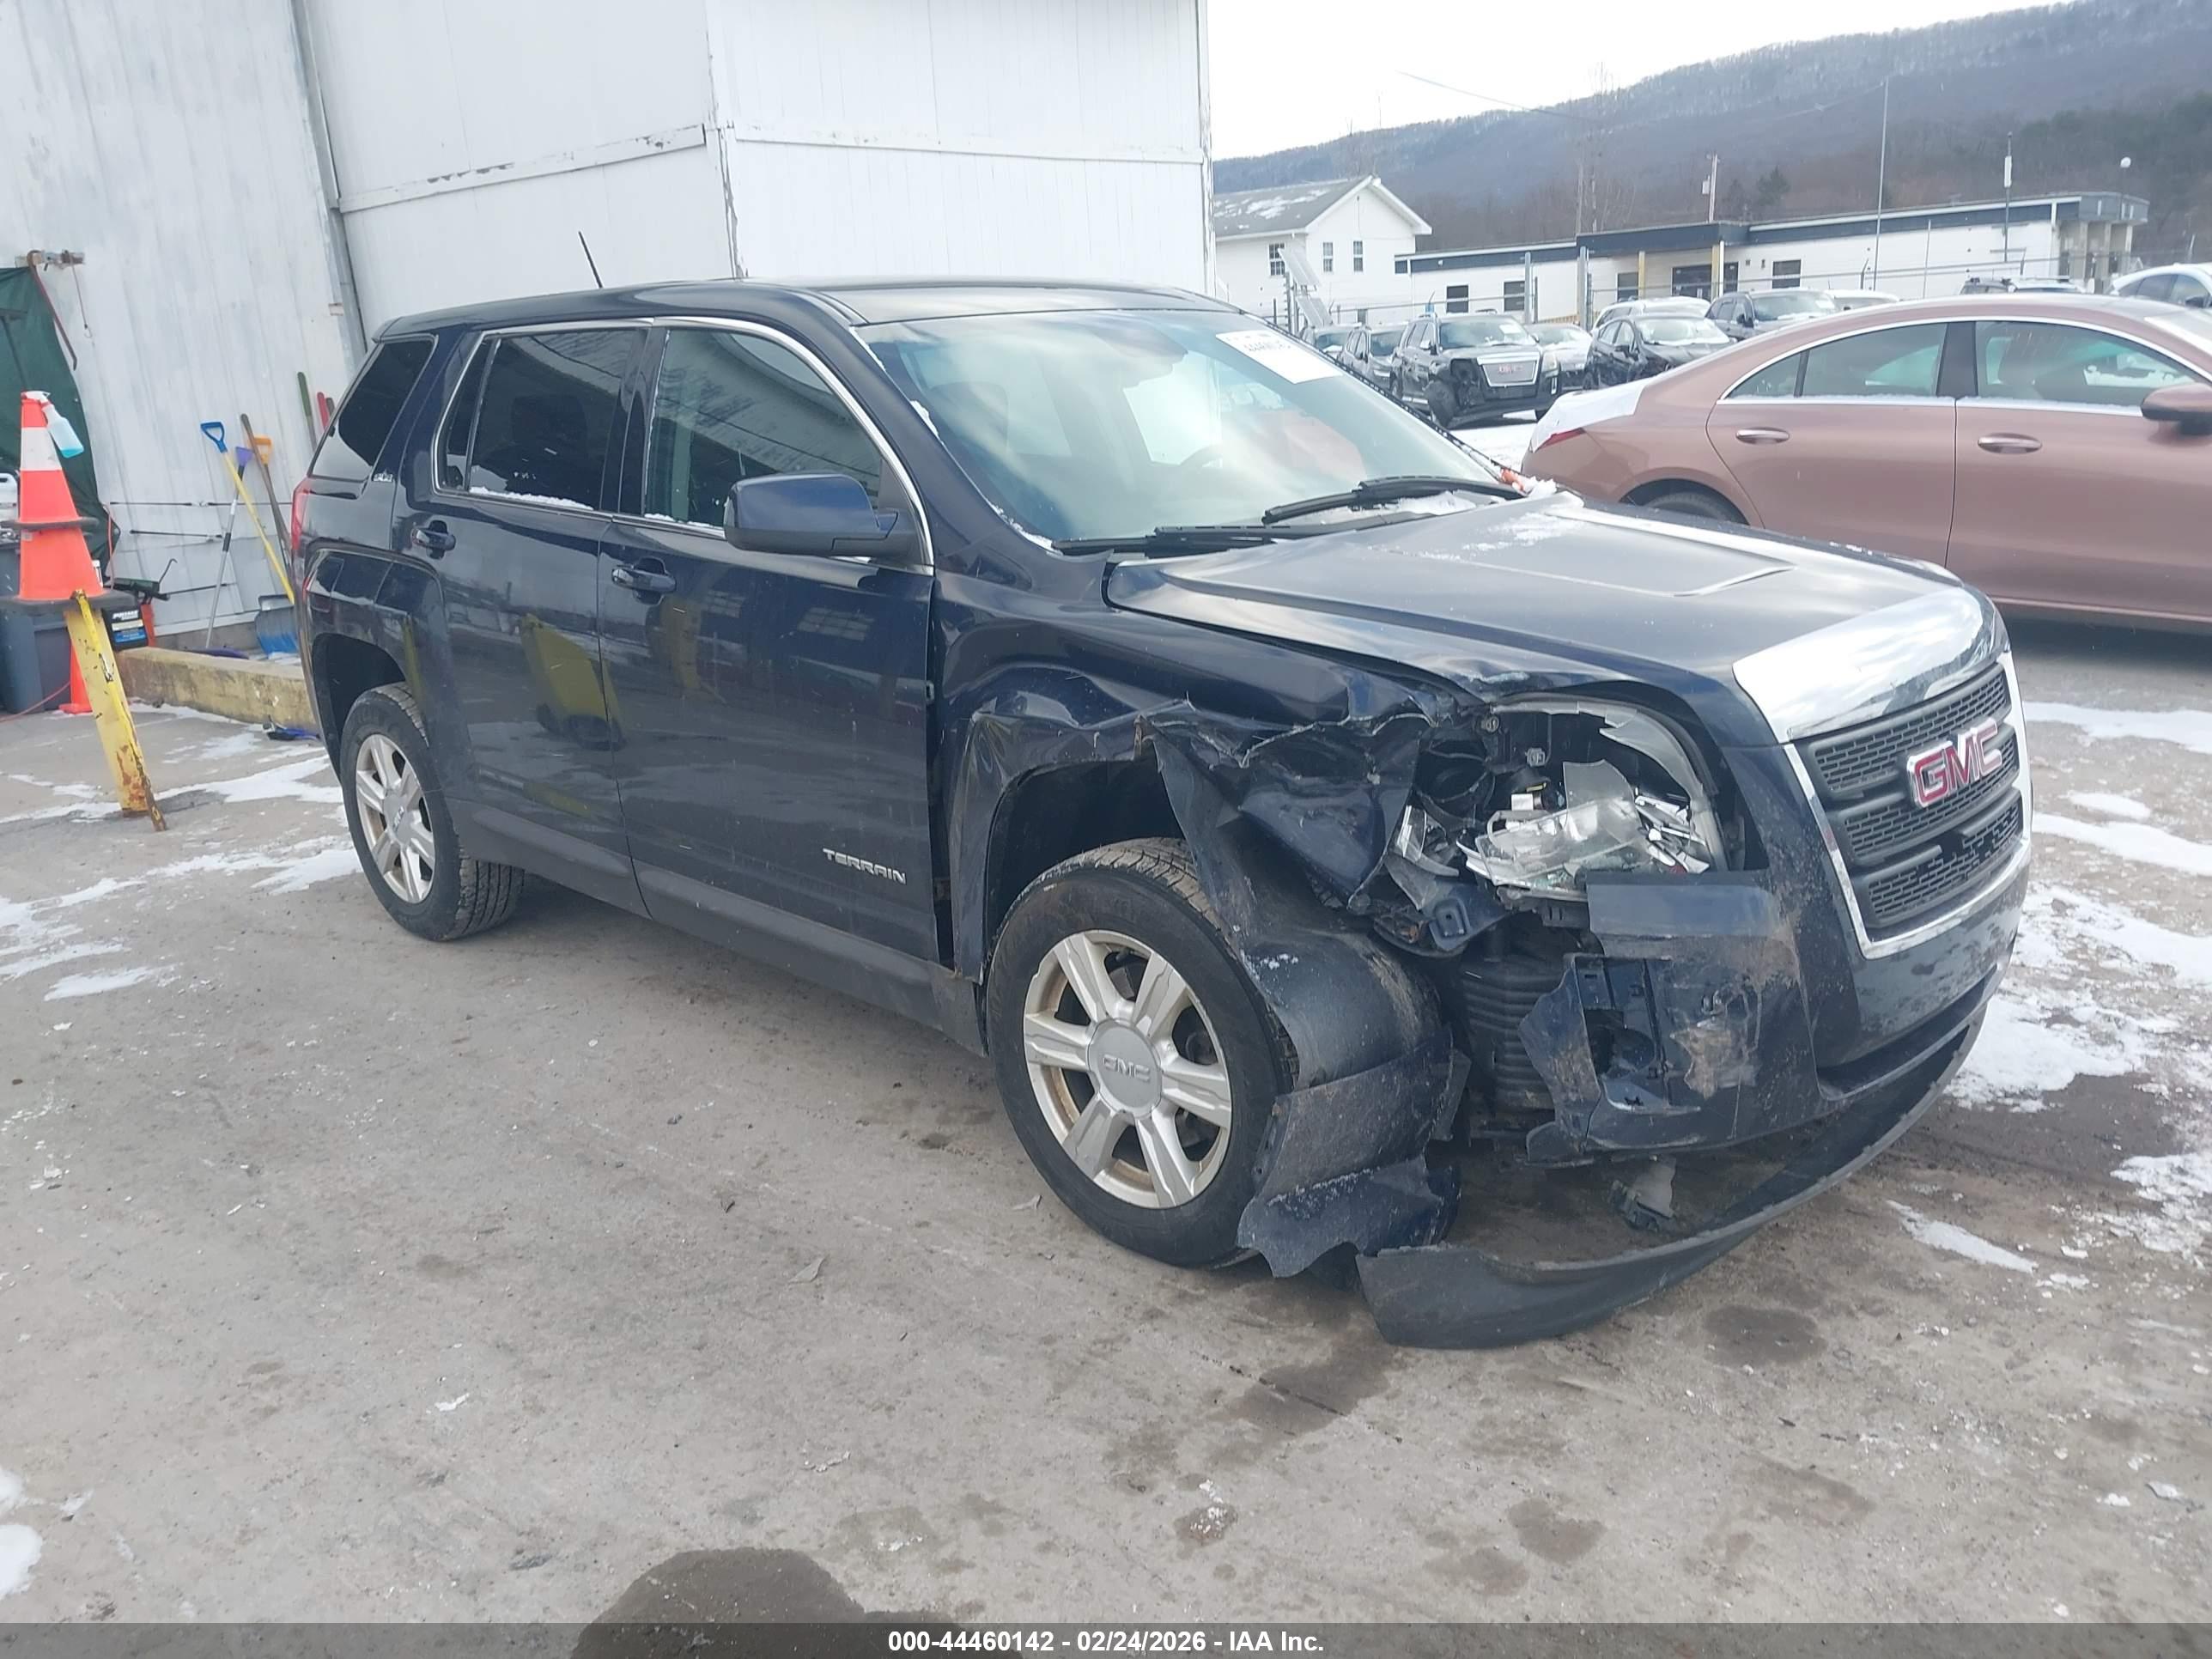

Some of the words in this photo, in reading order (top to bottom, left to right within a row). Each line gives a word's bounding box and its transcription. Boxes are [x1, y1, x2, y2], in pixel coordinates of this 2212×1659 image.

[1906, 717, 2002, 808] GMC
[823, 848, 907, 884] TERRAIN
[1102, 1054, 1151, 1084] GMC
